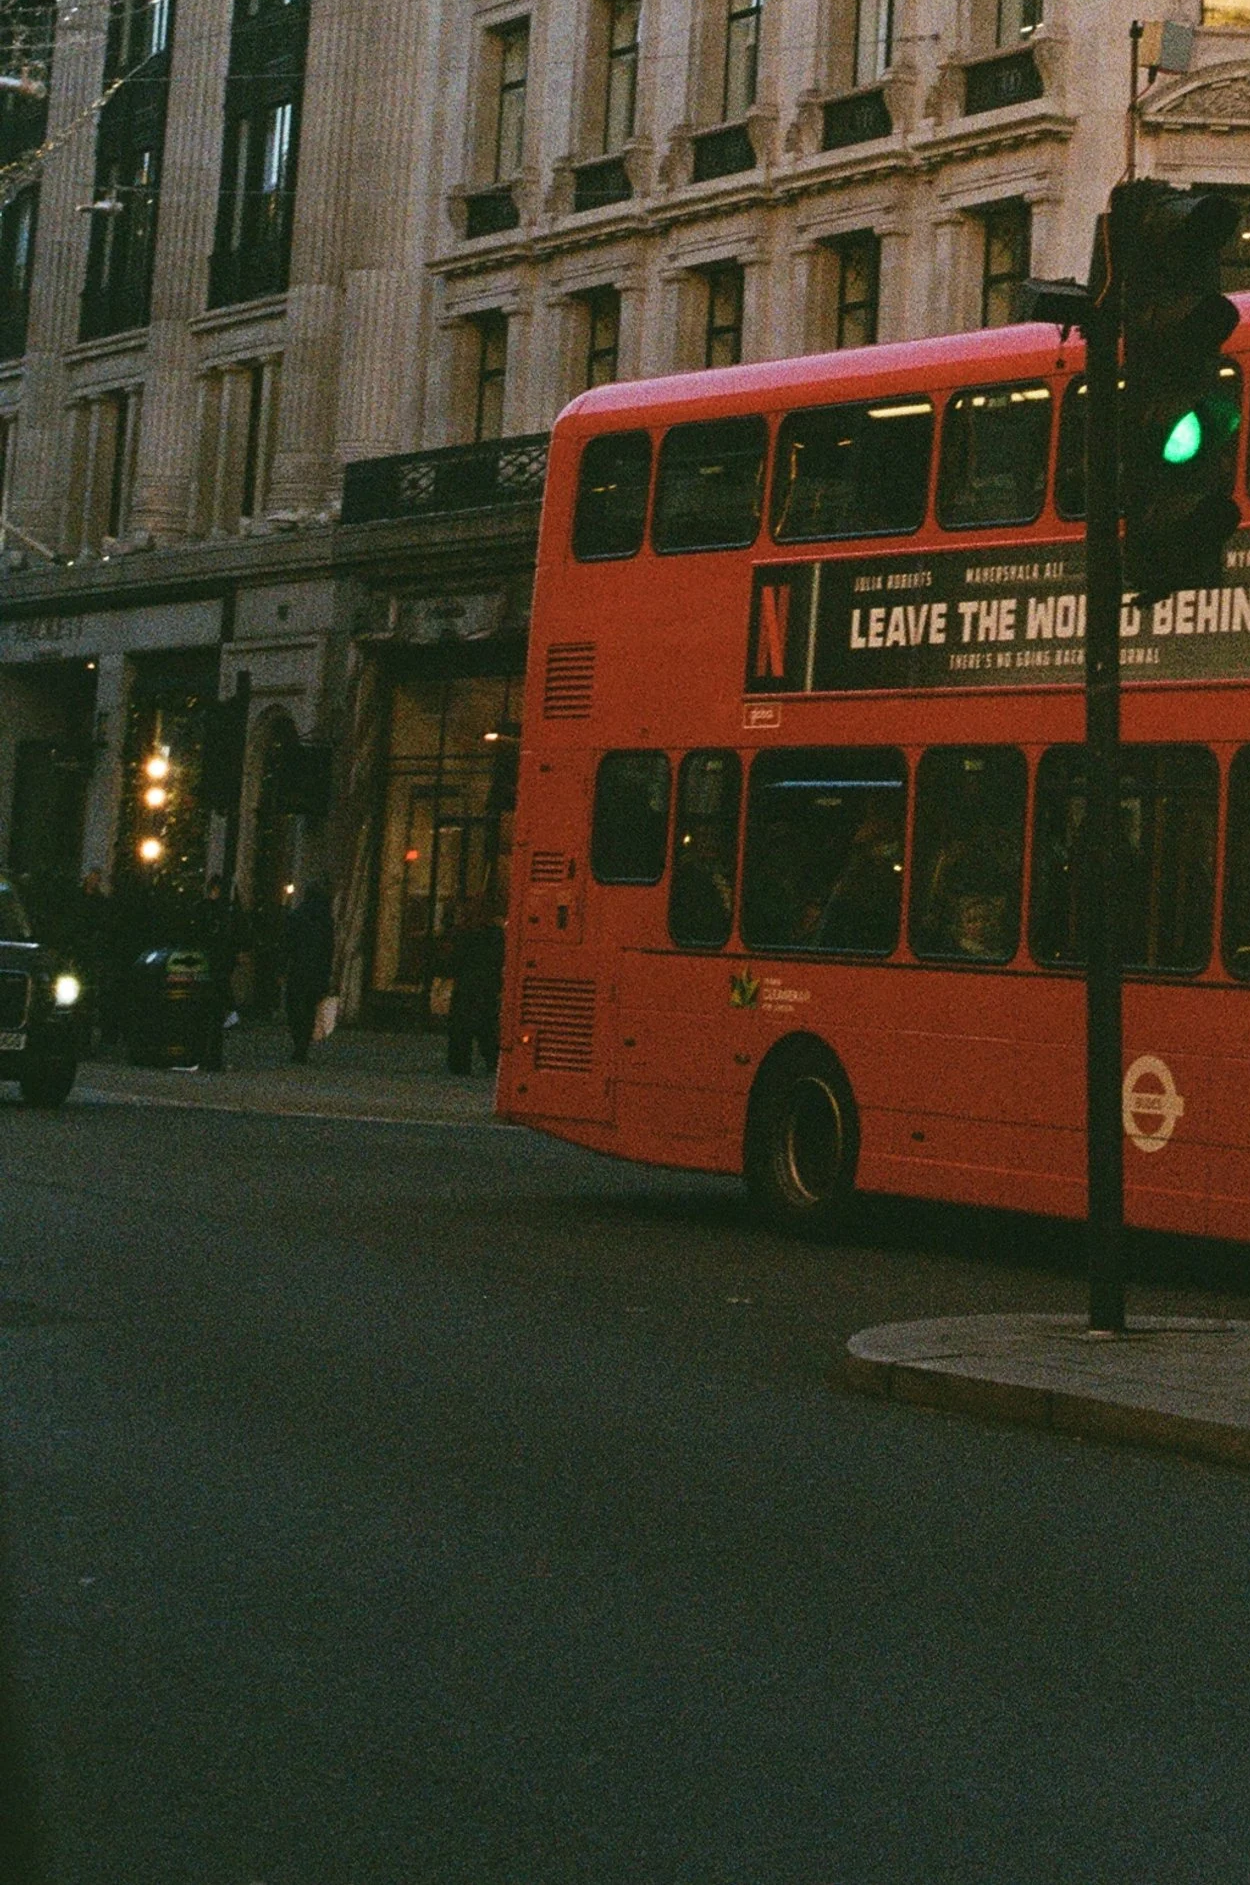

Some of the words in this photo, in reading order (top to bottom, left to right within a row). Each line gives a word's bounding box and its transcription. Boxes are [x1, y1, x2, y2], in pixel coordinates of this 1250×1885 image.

[886, 571, 933, 590] ROBERTS
[849, 602, 948, 649] LEAVE
[958, 598, 1017, 642] THE
